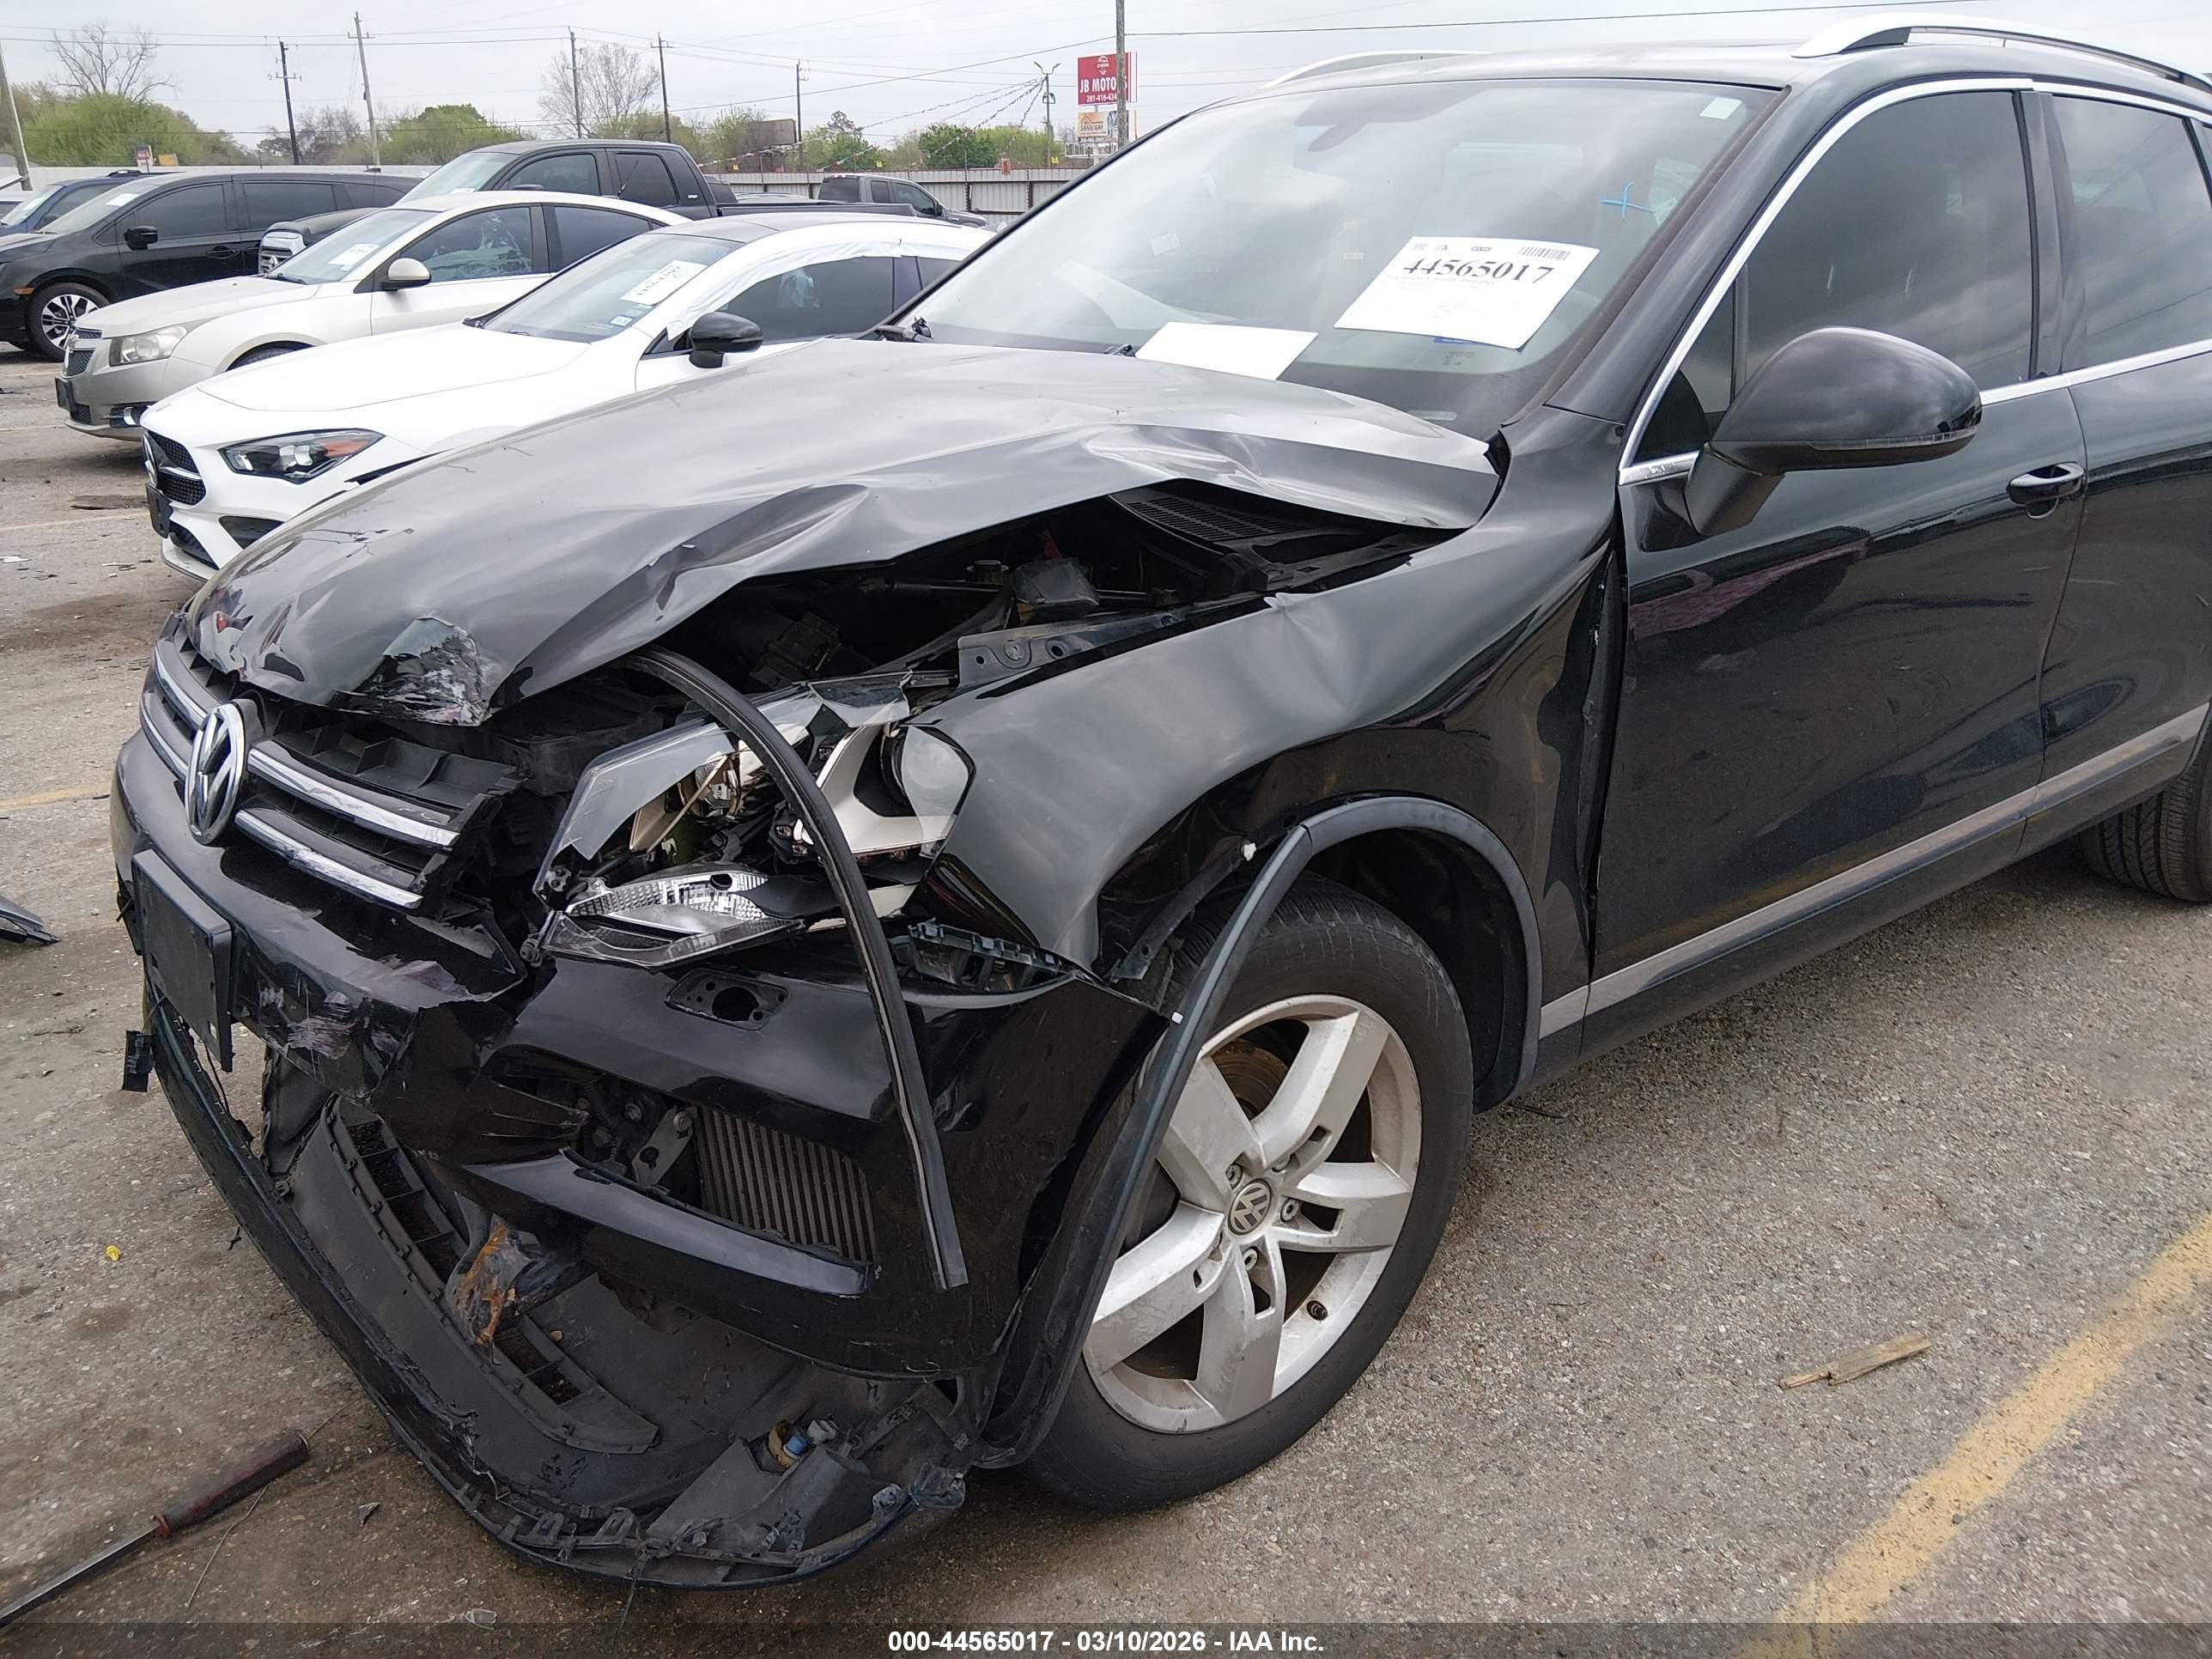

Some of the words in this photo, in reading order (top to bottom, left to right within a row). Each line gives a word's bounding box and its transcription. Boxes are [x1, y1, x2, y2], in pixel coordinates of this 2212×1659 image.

[1079, 79, 1090, 93] JB
[1092, 76, 1127, 93] MOTOS
[1403, 257, 1555, 283] 44565017
